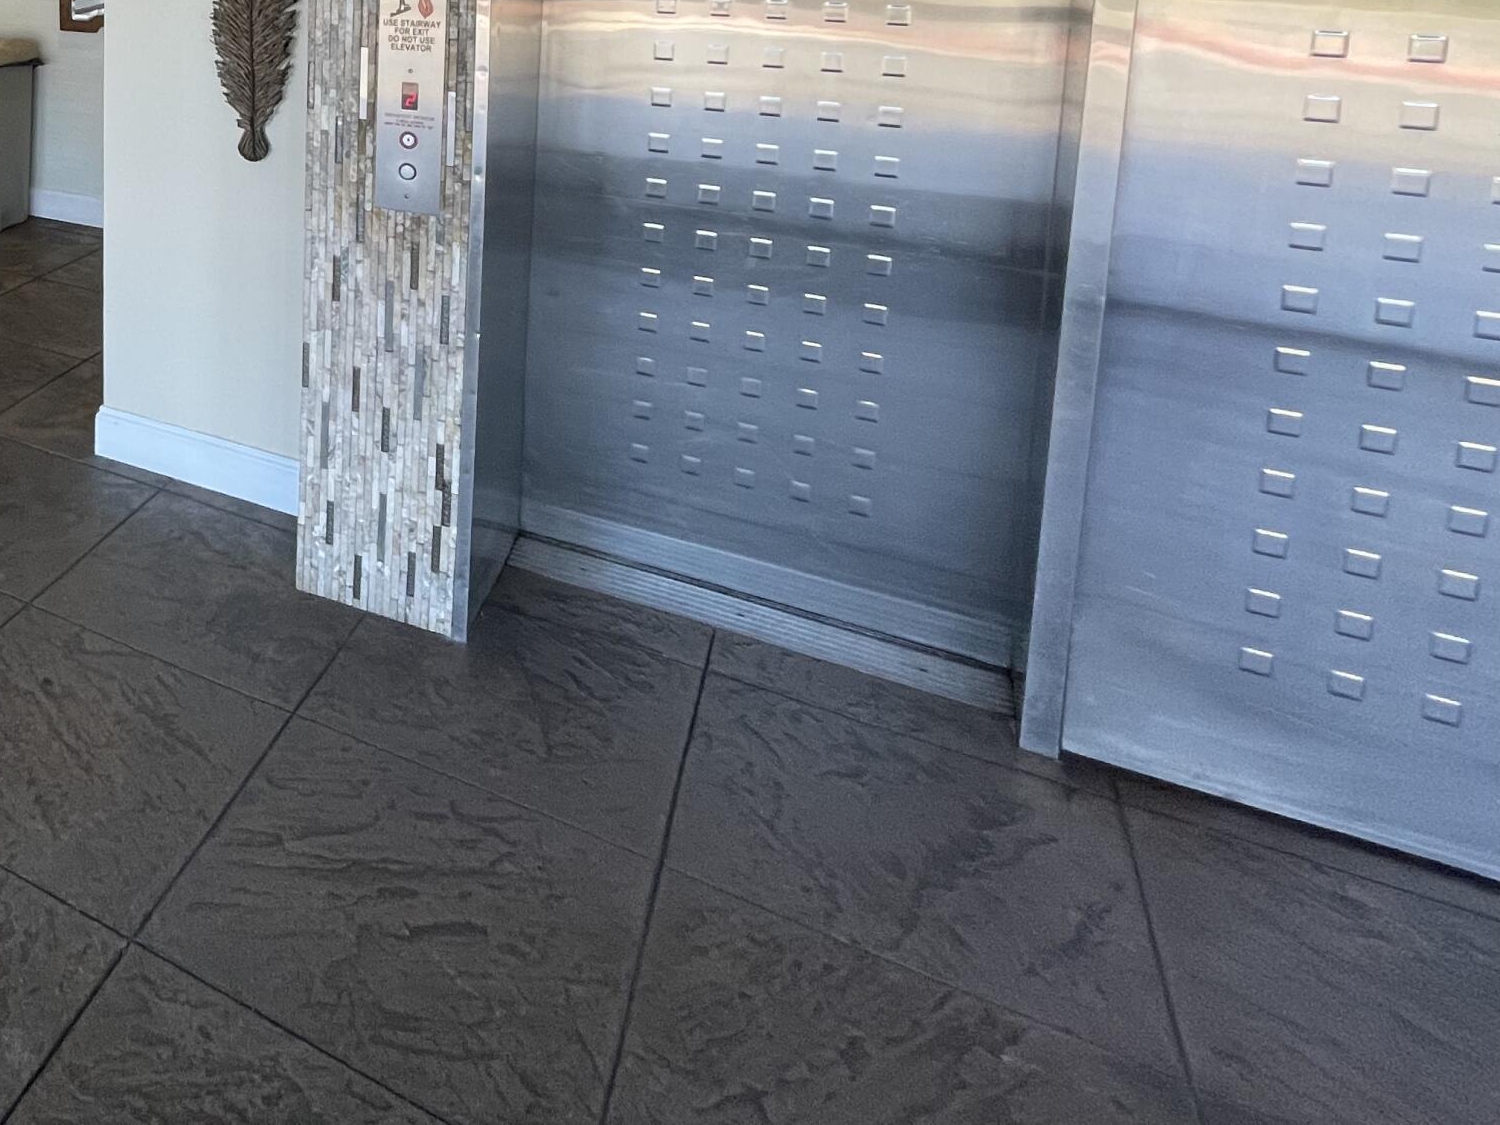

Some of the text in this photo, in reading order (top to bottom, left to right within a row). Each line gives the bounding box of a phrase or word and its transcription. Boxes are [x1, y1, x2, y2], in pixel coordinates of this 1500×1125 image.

[383, 19, 441, 28] USE STAIRWAY
[394, 27, 429, 36] FOR EXIT
[419, 36, 436, 44] USE
[390, 43, 432, 52] ELEVATOR
